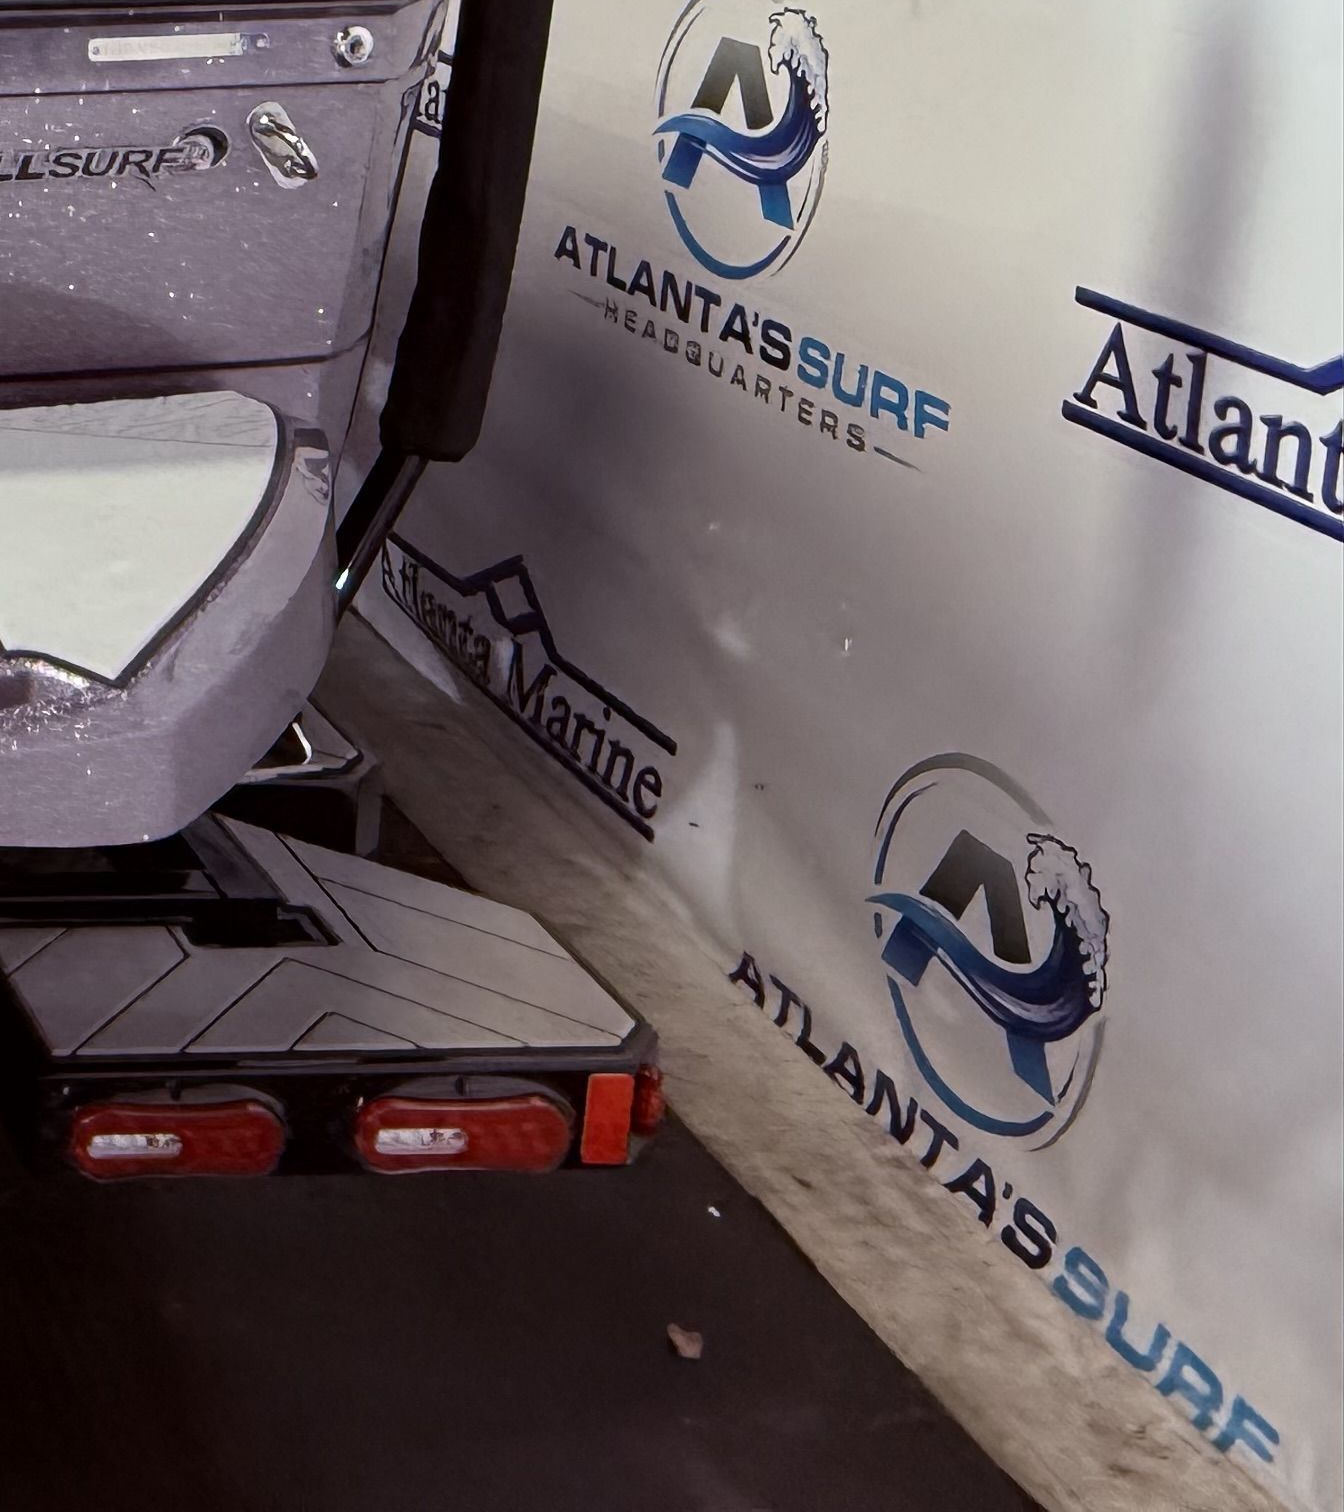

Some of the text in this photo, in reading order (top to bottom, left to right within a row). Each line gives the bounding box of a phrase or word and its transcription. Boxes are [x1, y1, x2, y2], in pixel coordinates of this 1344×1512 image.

[554, 225, 952, 440] ATLANTA'S SURF
[603, 296, 867, 454] HEADQUARTERS
[507, 638, 664, 819] Marine
[728, 950, 1281, 1465] ATLANTA'S SURF
